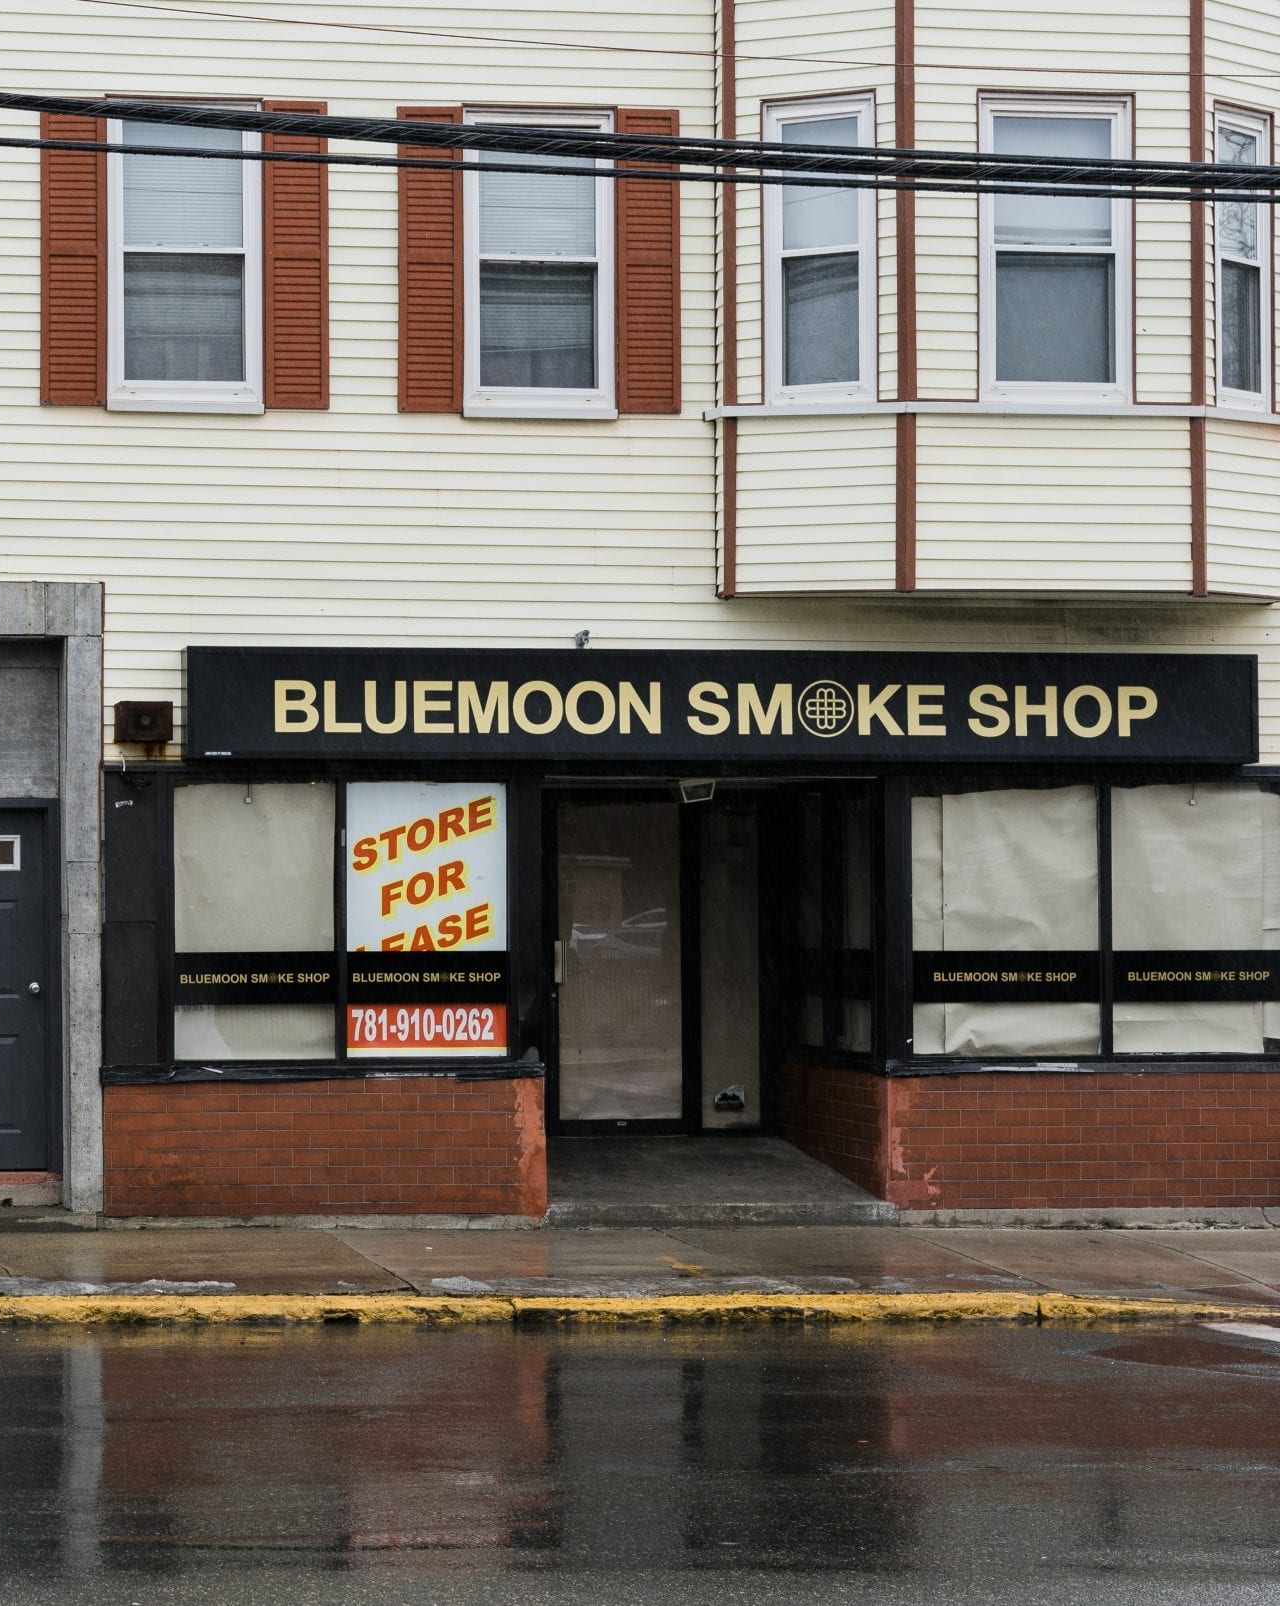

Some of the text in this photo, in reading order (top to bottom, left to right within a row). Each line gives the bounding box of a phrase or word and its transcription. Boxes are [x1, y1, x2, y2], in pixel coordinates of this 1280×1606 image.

[274, 680, 662, 735] BLUEMOON
[967, 684, 1158, 739] SHOP
[352, 795, 492, 872] STORE
[381, 860, 466, 917] FOR
[356, 902, 490, 952] EASE
[179, 972, 248, 984] BLUEMOON
[297, 972, 330, 984] SHOP
[352, 972, 420, 984] BLUEMOON
[468, 972, 502, 984] SHOP
[933, 972, 998, 982] BLUEMOON
[1045, 972, 1077, 982] SHOP
[1127, 972, 1192, 982] BLUEMOON
[1238, 972, 1270, 982] SHOP
[351, 1008, 495, 1042] 781-910-0262
